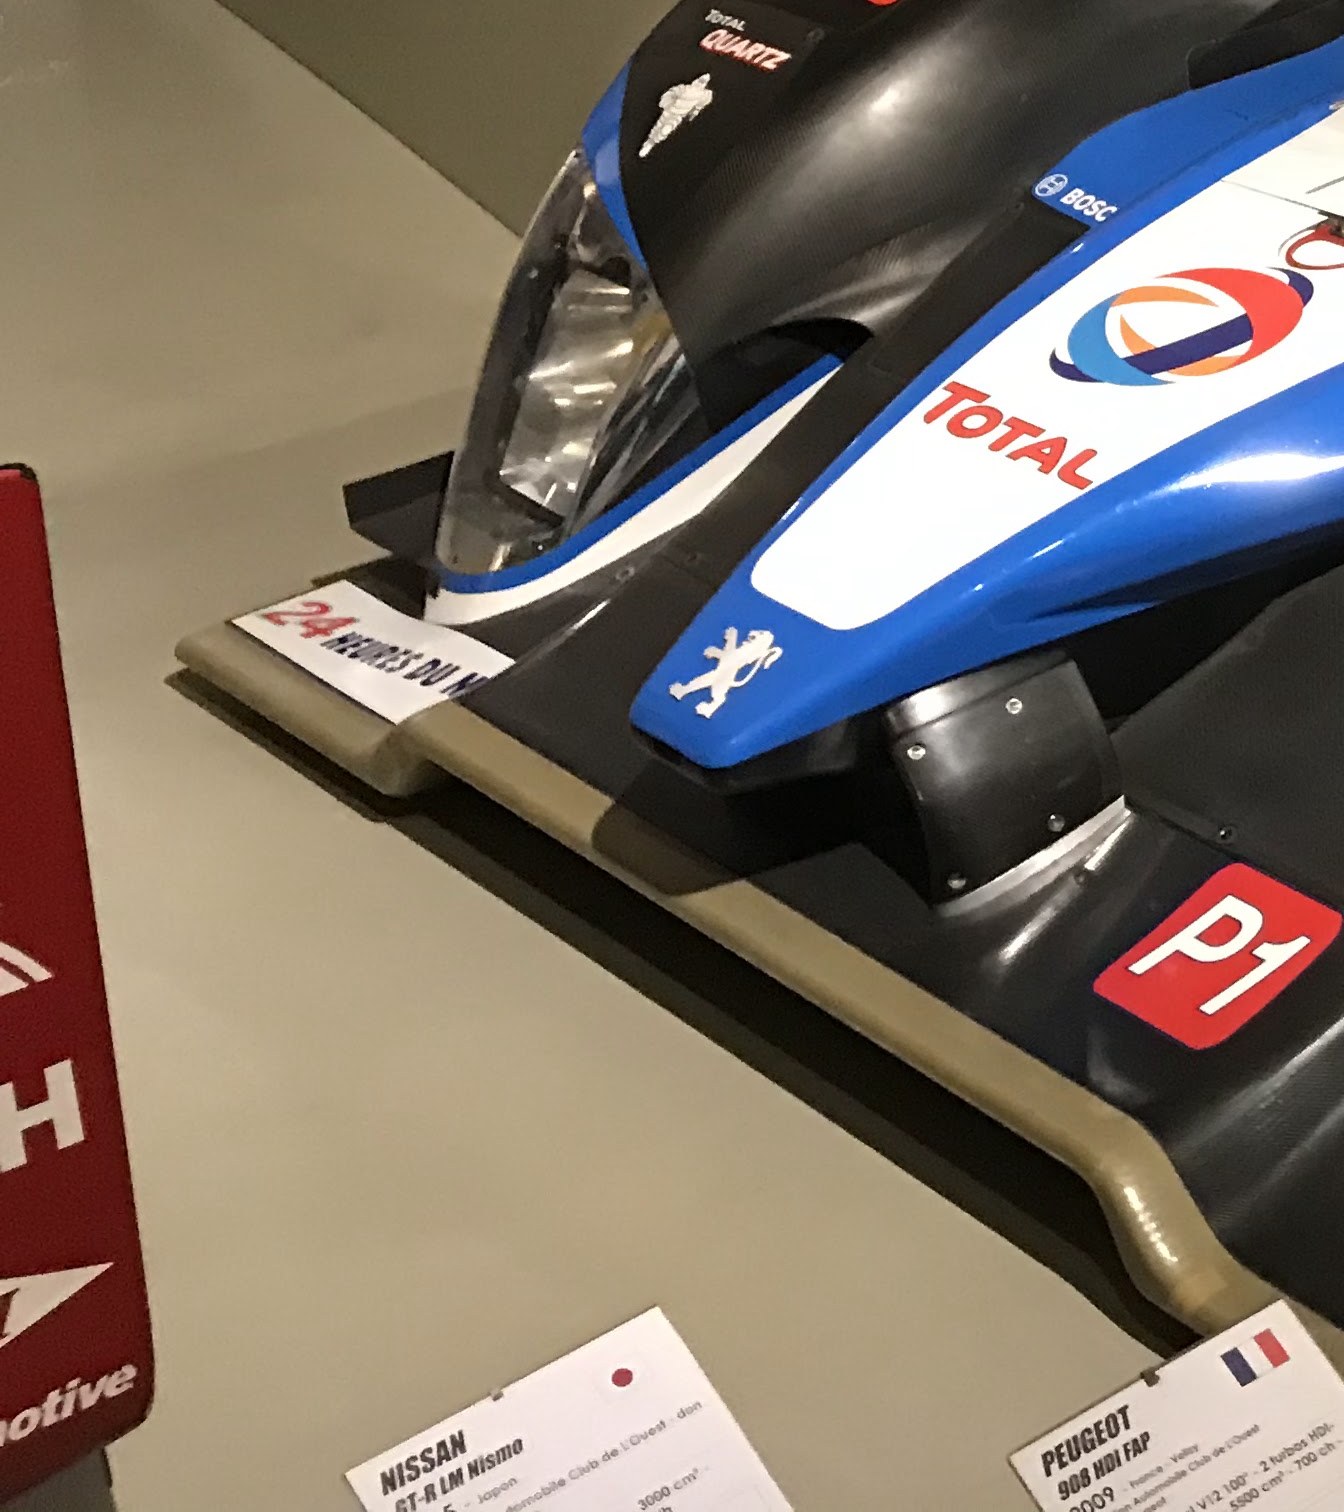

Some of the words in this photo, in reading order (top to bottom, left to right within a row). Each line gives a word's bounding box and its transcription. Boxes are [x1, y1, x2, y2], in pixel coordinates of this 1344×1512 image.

[700, 29, 792, 72] QUARTZ
[706, 9, 746, 31] TOTAL
[1060, 187, 1118, 223] BOSC
[923, 381, 1097, 490] TOTAL
[261, 601, 359, 638] 24
[320, 631, 424, 674] HEURES
[403, 658, 462, 687] DU
[1127, 893, 1311, 1015] P1
[380, 1430, 467, 1496] NISSAN
[395, 1482, 437, 1512] GT-R
[439, 1467, 464, 1495] LM
[468, 1438, 524, 1481] Nismo
[568, 1459, 599, 1481] Club
[602, 1447, 620, 1462] de
[676, 1400, 703, 1419] don
[1041, 1404, 1131, 1478] PEUGEOT
[1057, 1466, 1093, 1502] 908
[1122, 1431, 1151, 1462] FAP
[1196, 1490, 1223, 1512] V12
[1259, 1460, 1271, 1473] 2
[1270, 1438, 1309, 1467] turbos
[1229, 1487, 1260, 1512] 5500
[1295, 1451, 1318, 1472] 700
[1318, 1441, 1336, 1458] ch
[637, 1486, 671, 1511] 3000
